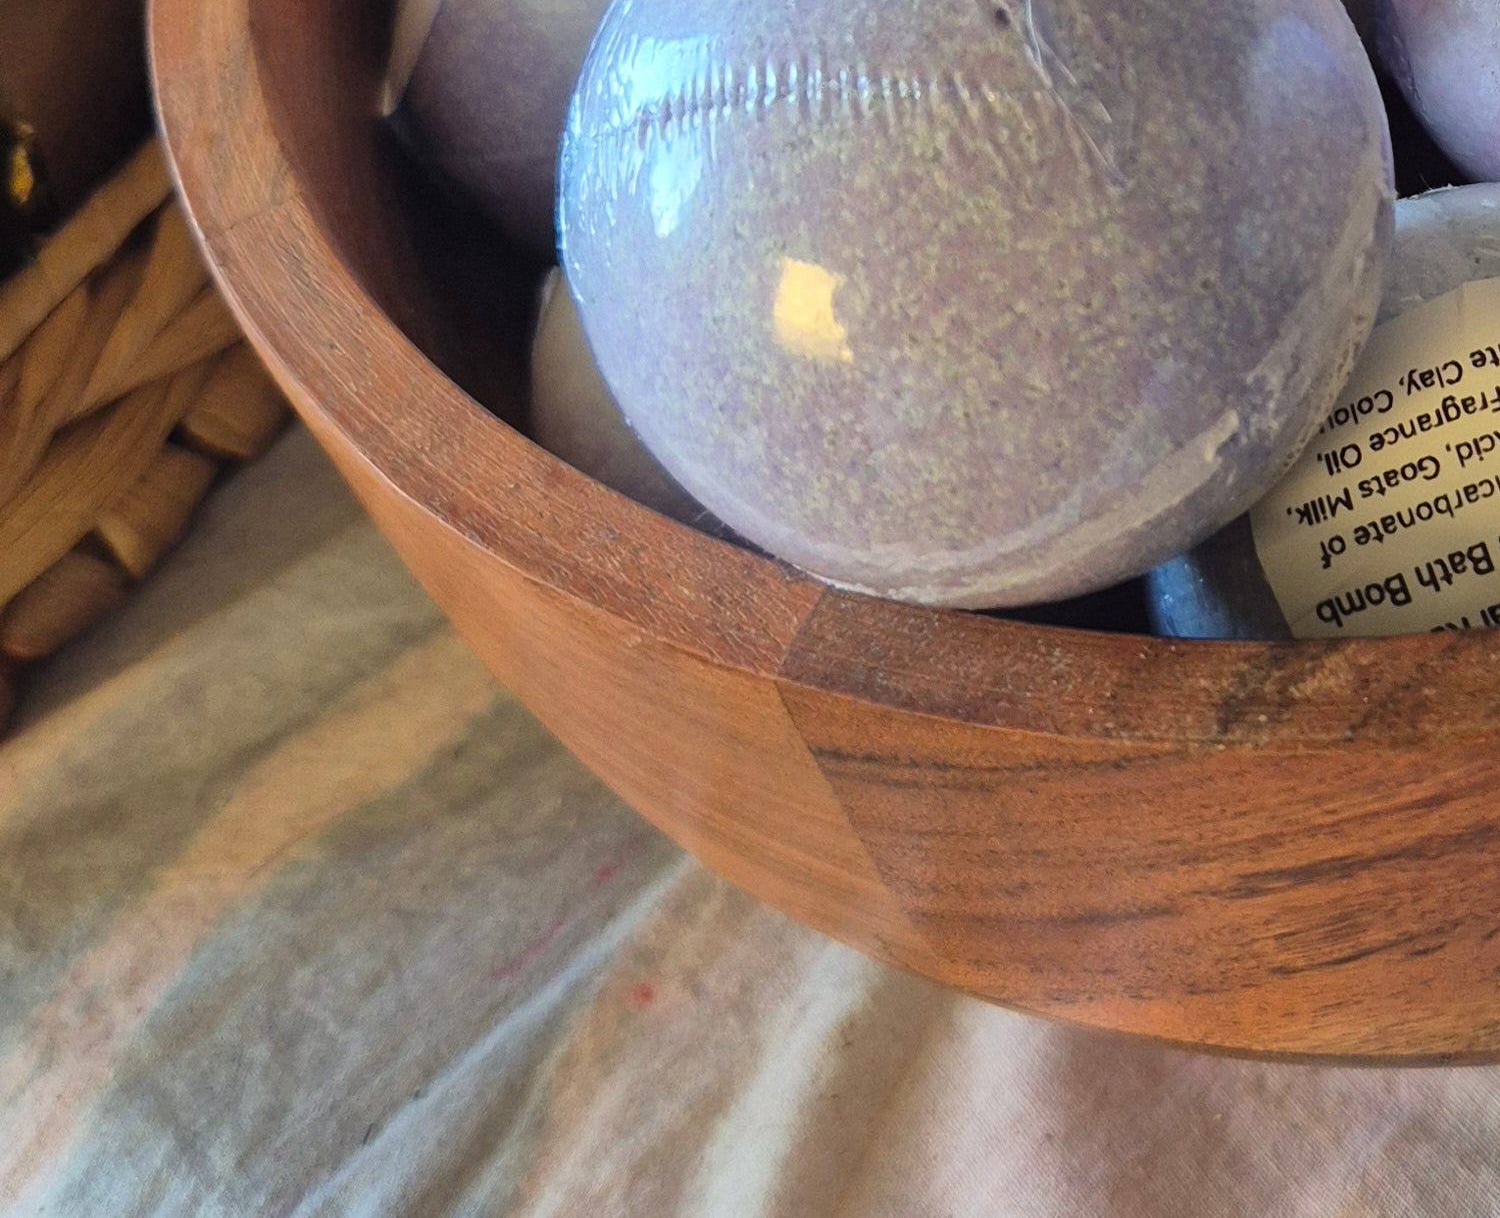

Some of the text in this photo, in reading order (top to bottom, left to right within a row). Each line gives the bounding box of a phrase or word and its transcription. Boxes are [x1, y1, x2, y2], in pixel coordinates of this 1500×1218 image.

[1399, 360, 1462, 395] Clay,
[1317, 443, 1362, 476] Oil,
[1358, 456, 1440, 499] Goats
[1287, 488, 1353, 526] Milk,
[1321, 535, 1346, 569] of
[1415, 542, 1494, 592] Bath
[1316, 573, 1411, 627] Bomb
